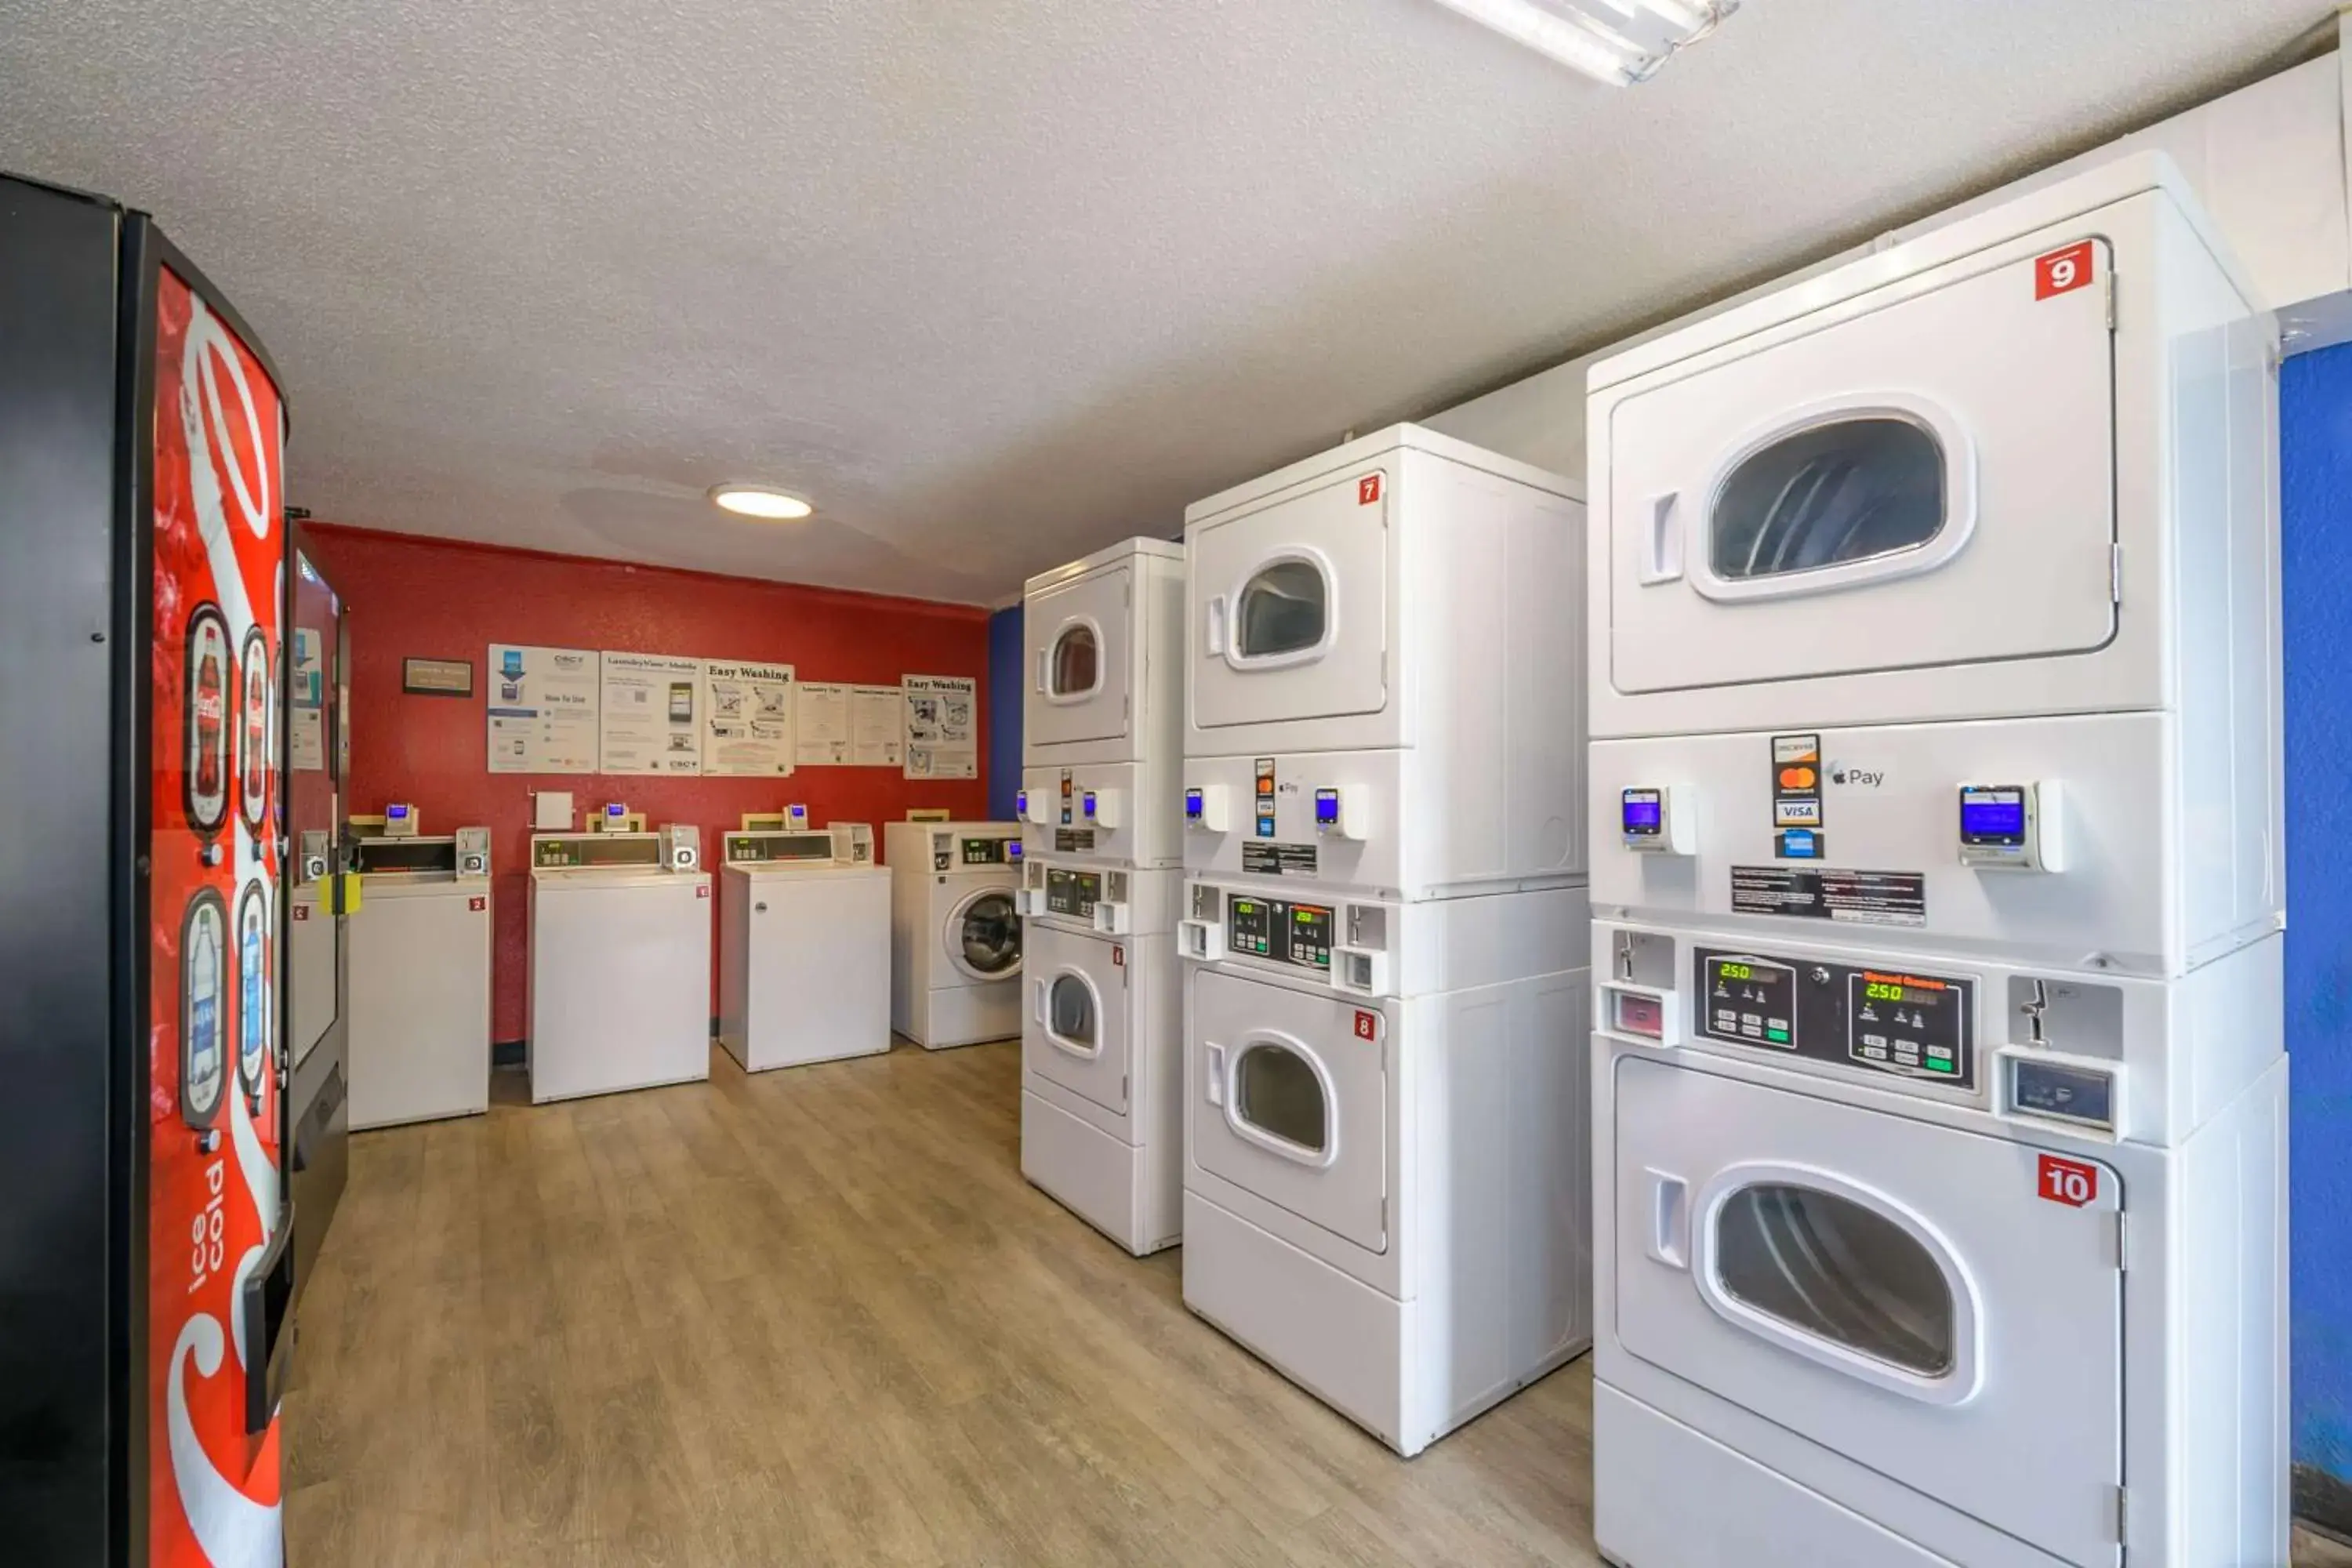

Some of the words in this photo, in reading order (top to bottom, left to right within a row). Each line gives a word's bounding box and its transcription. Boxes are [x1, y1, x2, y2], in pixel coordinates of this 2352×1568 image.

[2051, 259, 2076, 289] 9
[1364, 483, 1374, 501] 7
[709, 665, 737, 680] Easy
[740, 666, 790, 683] Washing
[907, 678, 929, 691] Easy
[932, 679, 971, 692] Washing
[1849, 769, 1884, 788] Pay
[1784, 806, 1813, 817] VISA
[1359, 1019, 1370, 1036] 8
[2045, 1169, 2089, 1202] 10
[205, 1158, 224, 1272] cold
[188, 1212, 206, 1294] ice
